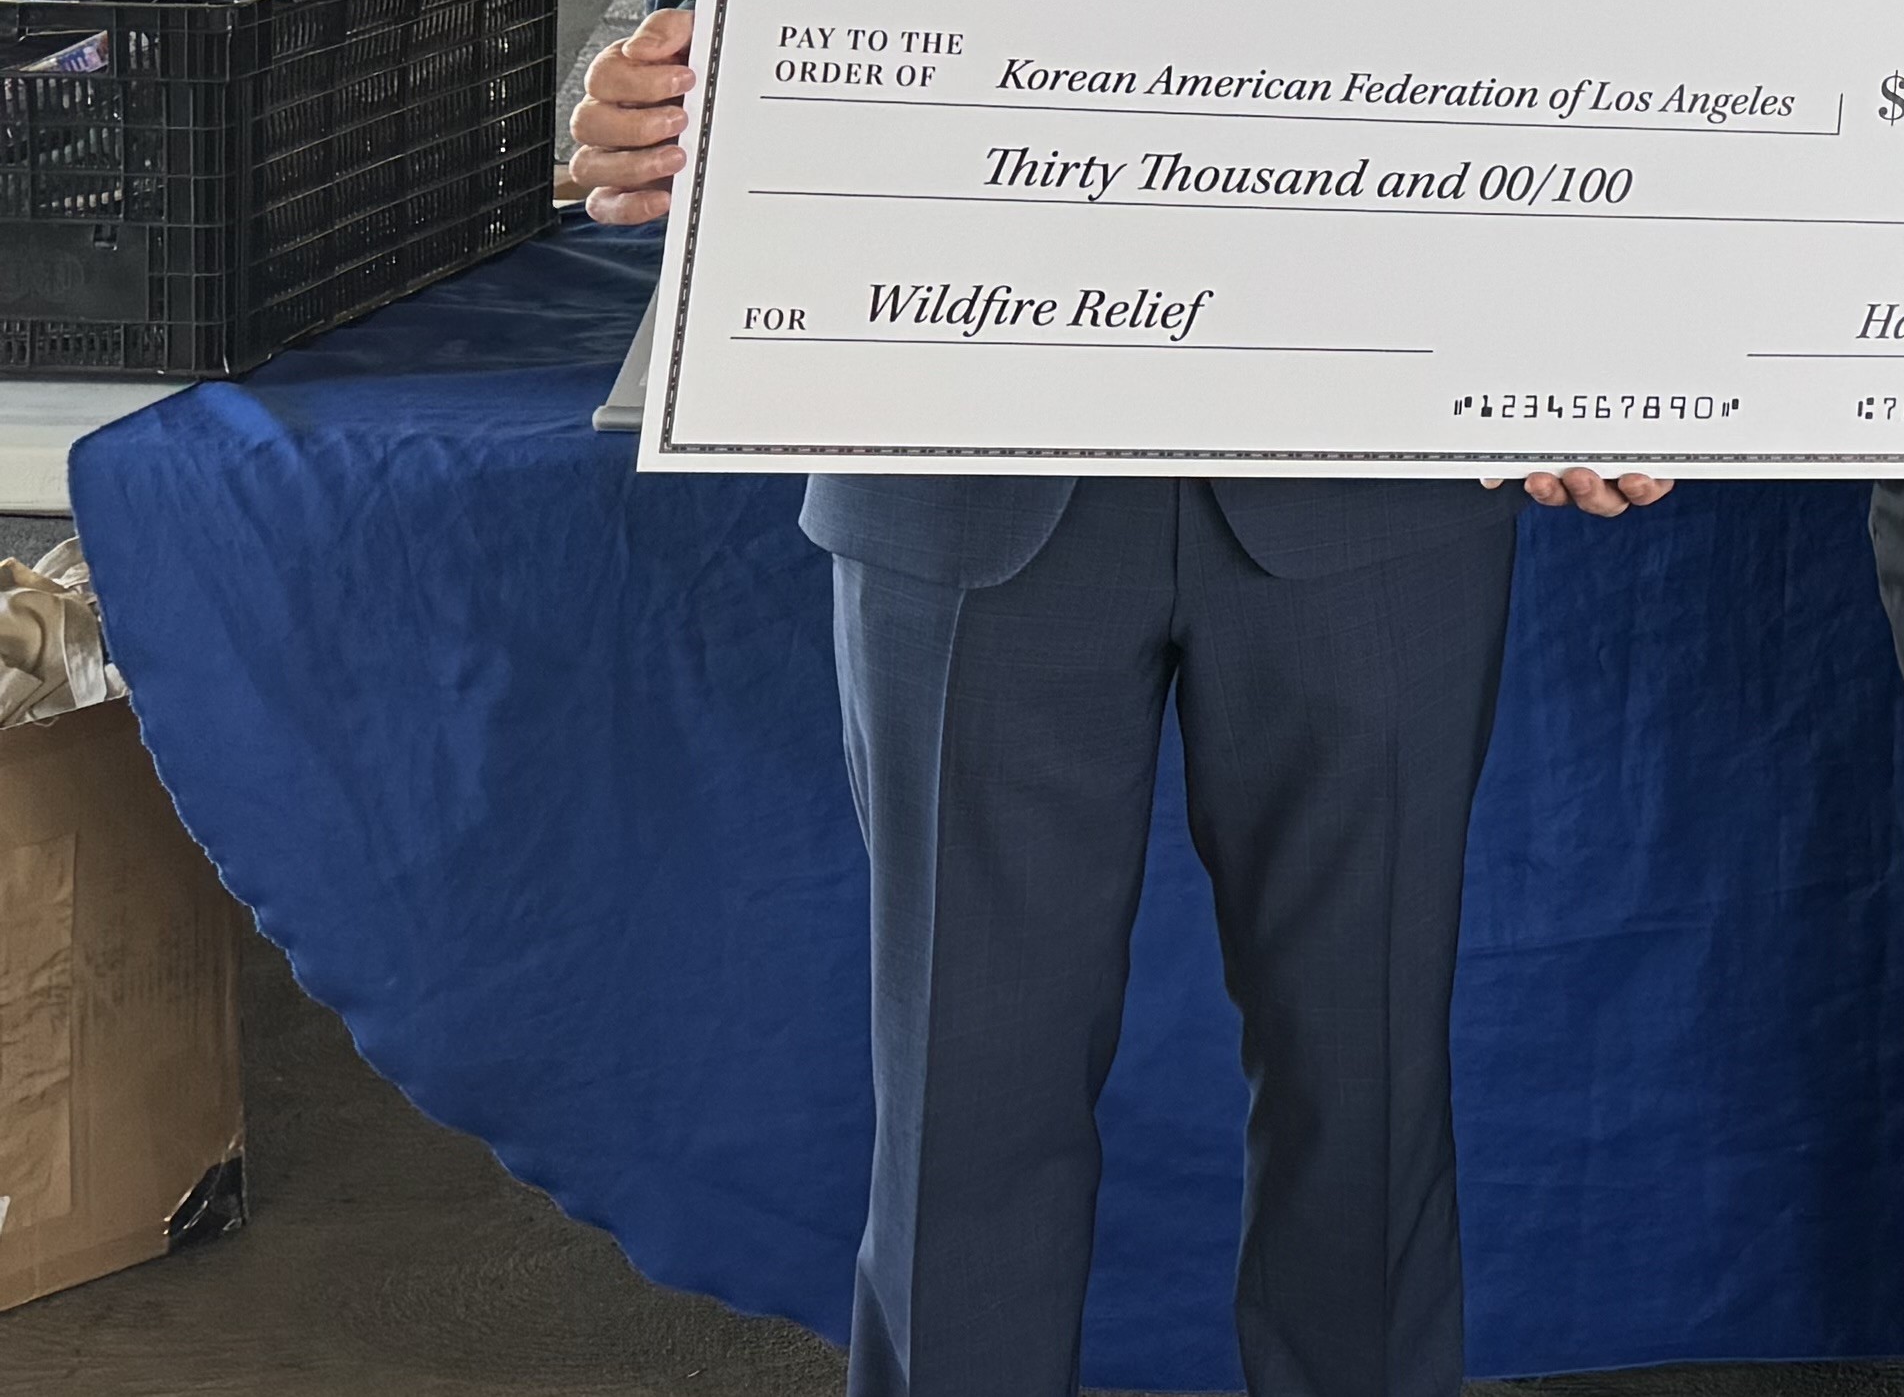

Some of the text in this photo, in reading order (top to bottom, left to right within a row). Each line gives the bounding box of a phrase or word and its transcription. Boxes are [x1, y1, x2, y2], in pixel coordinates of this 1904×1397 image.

[779, 25, 964, 56] PAY TO THE
[774, 59, 936, 87] ORDER OF
[996, 58, 1795, 122] Korean American Federation of Los Angeles
[983, 146, 1633, 207] Thirty Thousand and 00/100
[743, 283, 1214, 340] FOR Wildfire Relief
